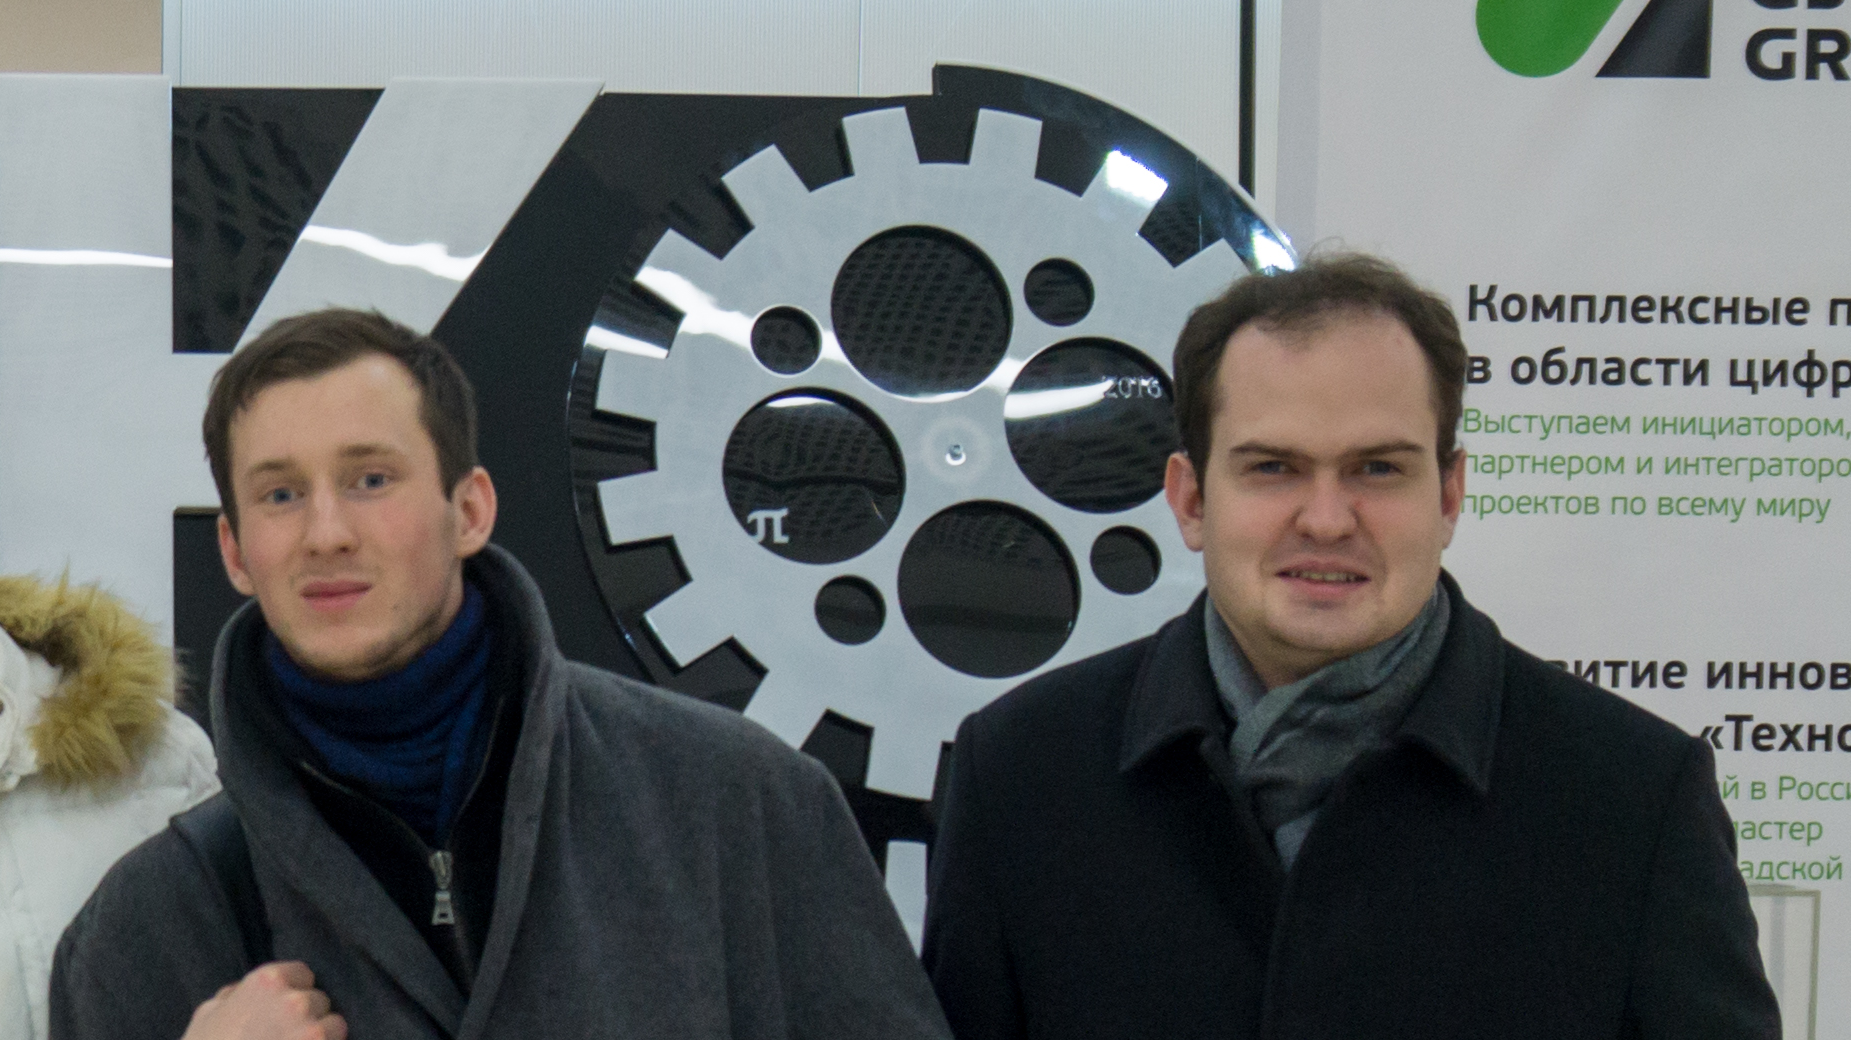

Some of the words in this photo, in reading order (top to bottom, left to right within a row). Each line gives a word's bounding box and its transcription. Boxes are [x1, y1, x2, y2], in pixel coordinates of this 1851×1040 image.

[1745, 28, 1851, 81] GR
[1468, 284, 1810, 326] Комплексные
[1467, 356, 1492, 384] в
[1511, 346, 1710, 387] области
[1463, 408, 1631, 440] Выступаем
[1636, 456, 1653, 474] и
[1664, 456, 1851, 483] интеграторо
[1461, 494, 1599, 520] проектов
[1611, 496, 1646, 515] по
[1657, 497, 1746, 523] всему
[1756, 498, 1832, 523] миру
[1751, 781, 1766, 800] в
